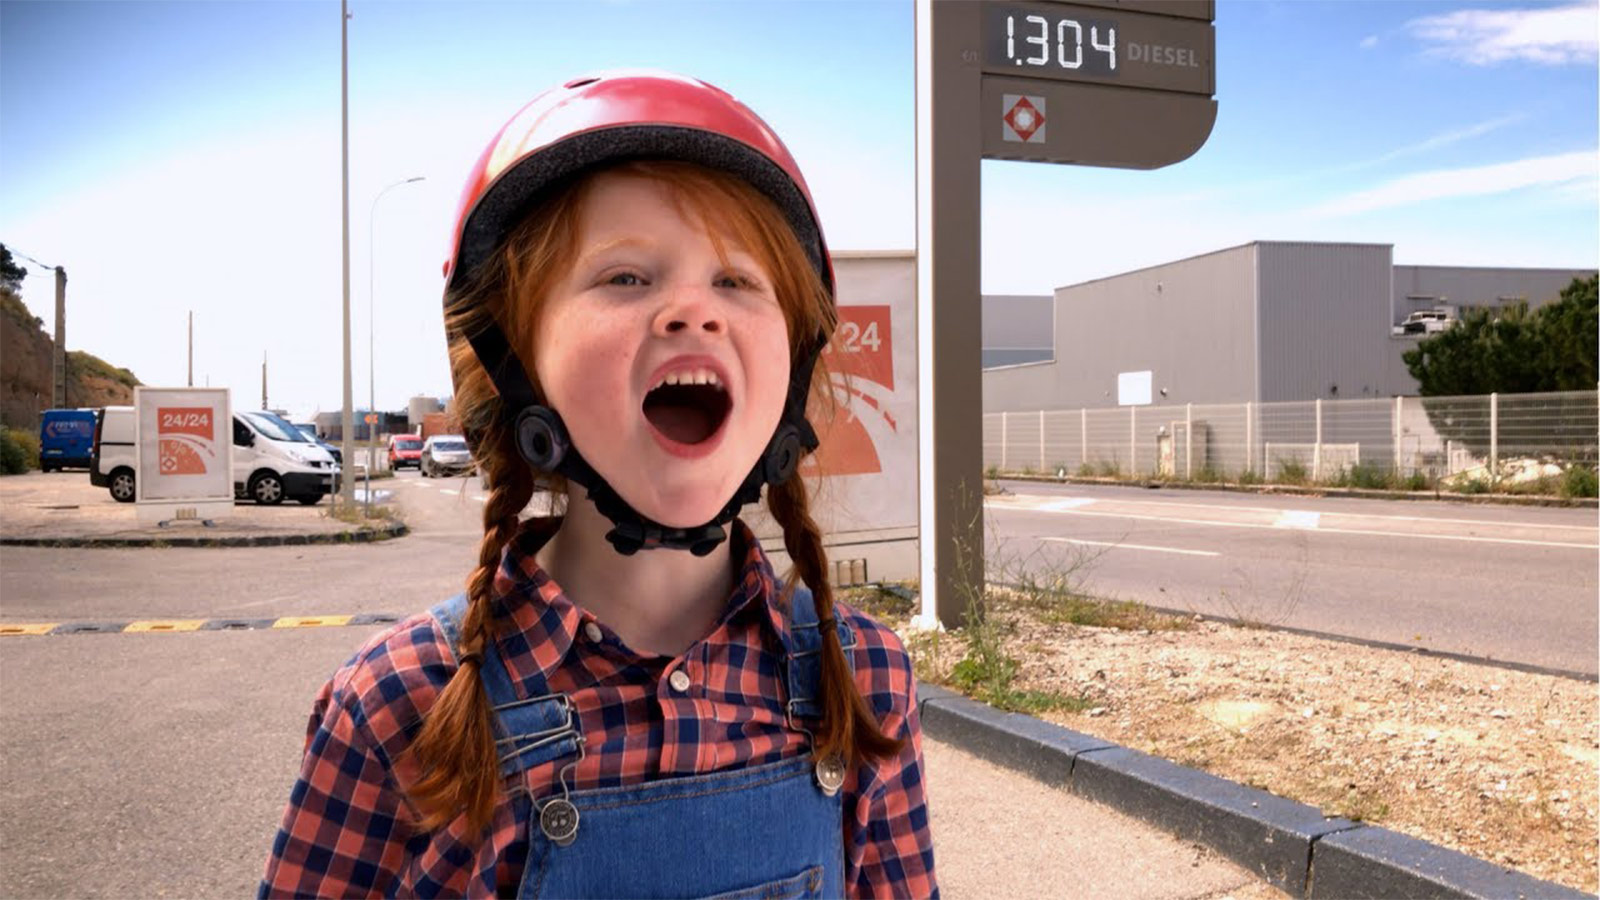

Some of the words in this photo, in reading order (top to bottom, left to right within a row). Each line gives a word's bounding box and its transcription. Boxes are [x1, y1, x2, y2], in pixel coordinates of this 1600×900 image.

[1007, 15, 1116, 70] 1.304
[1127, 43, 1199, 68] DIESEL
[163, 413, 209, 427] 24/24
